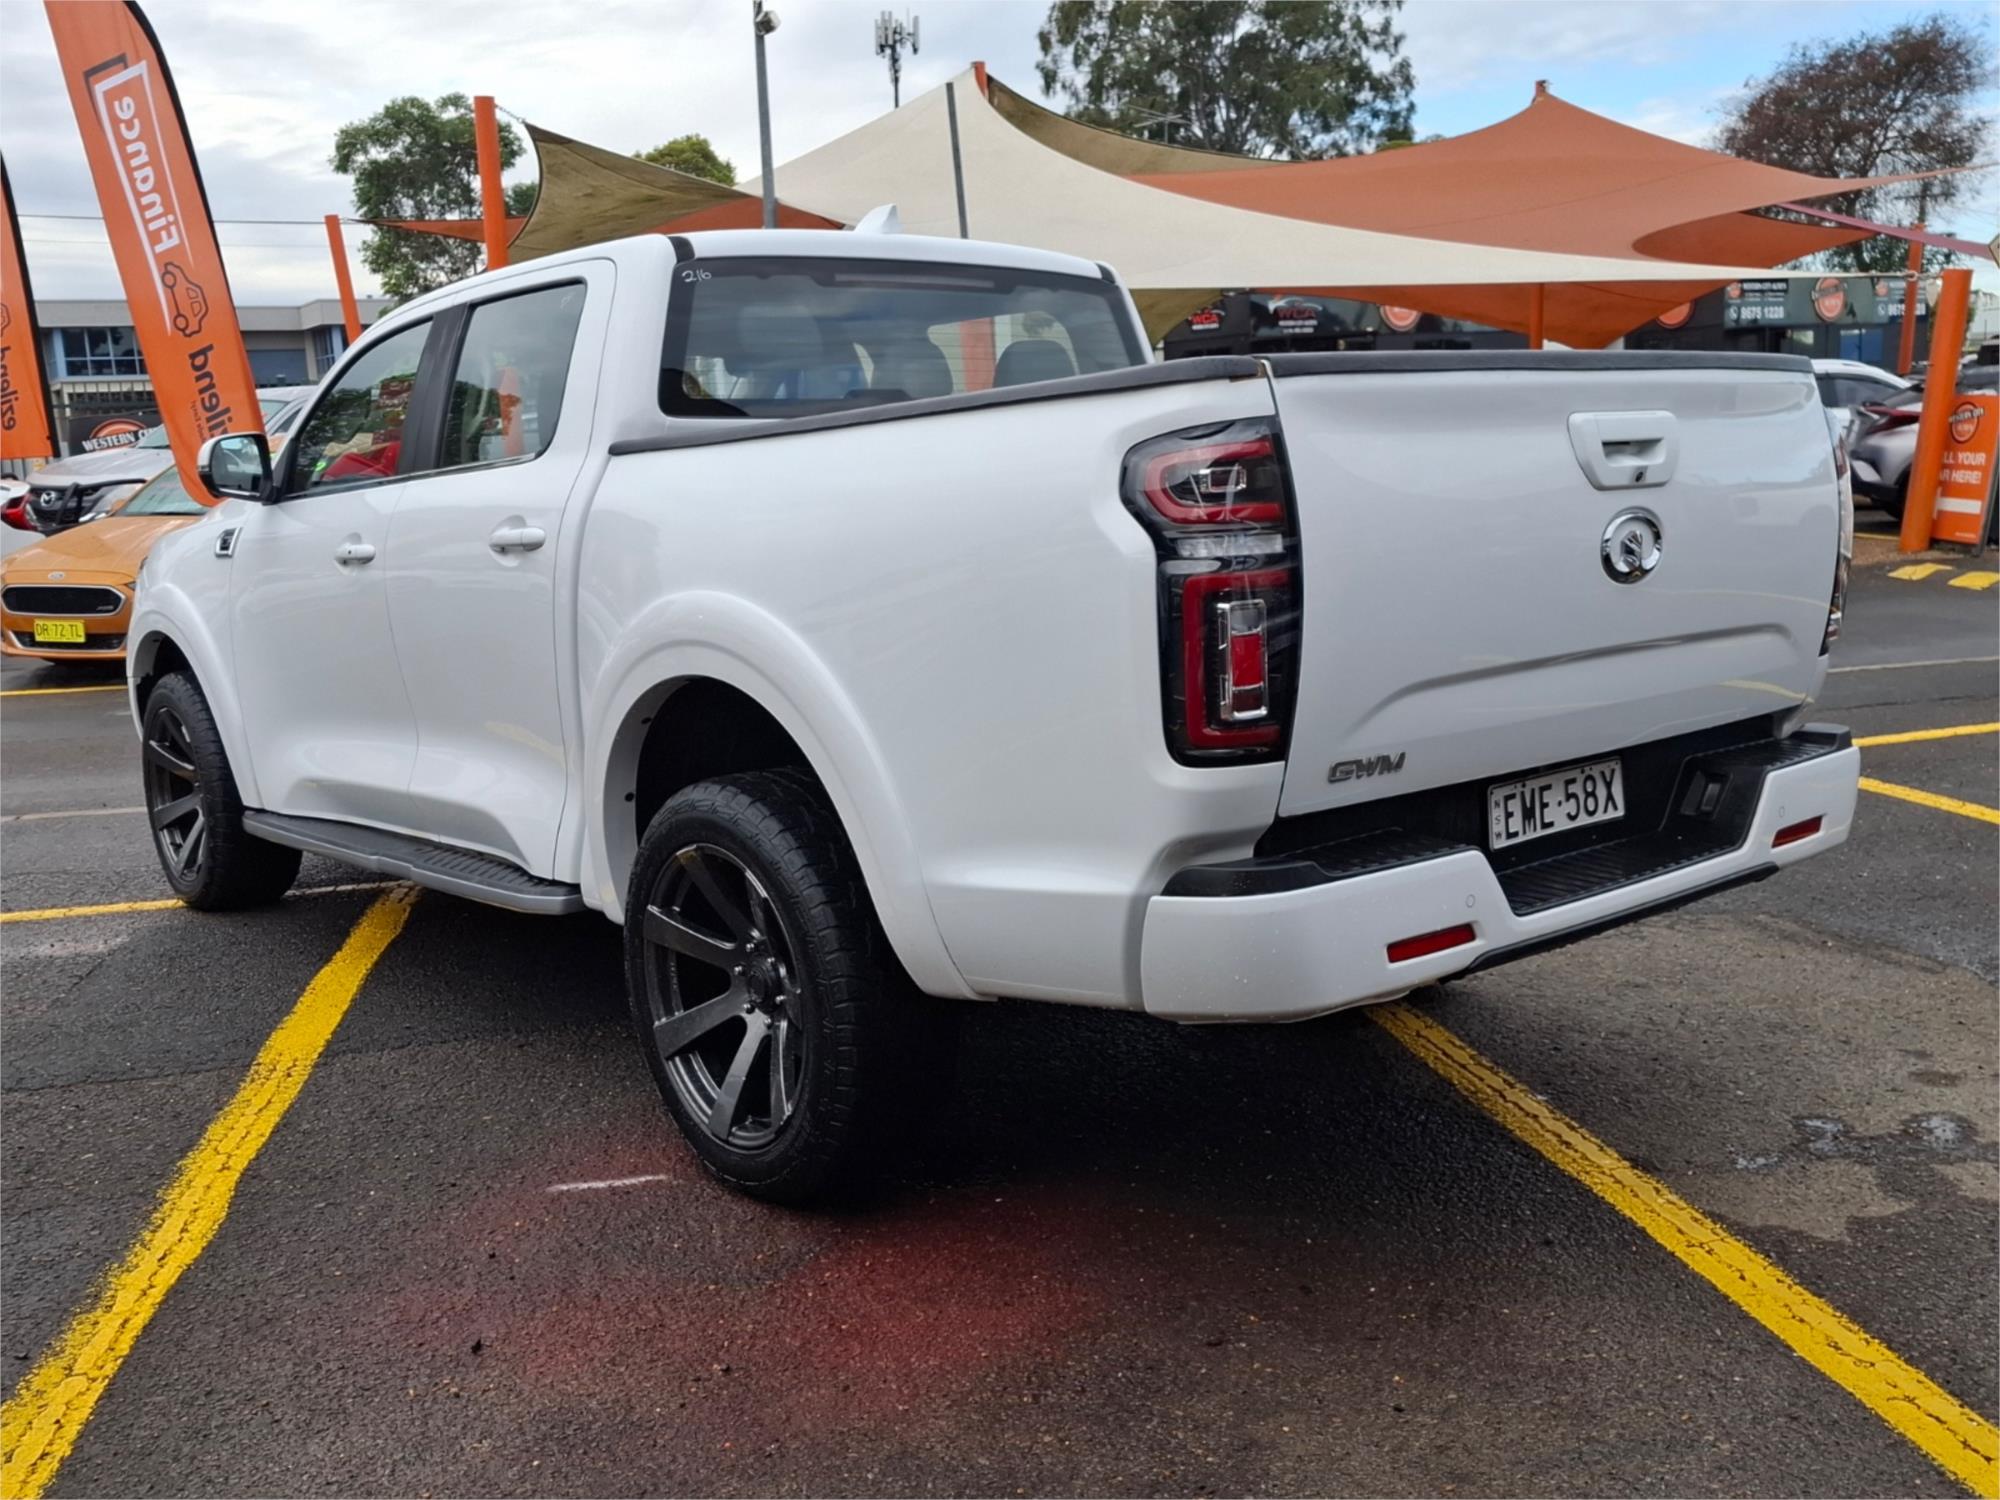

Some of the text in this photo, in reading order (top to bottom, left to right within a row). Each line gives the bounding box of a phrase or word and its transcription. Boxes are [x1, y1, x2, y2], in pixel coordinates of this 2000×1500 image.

[682, 269, 712, 282] 216
[81, 431, 136, 452] WESTERN
[1957, 452, 1987, 466] YOUR
[1327, 751, 1406, 783] GWM
